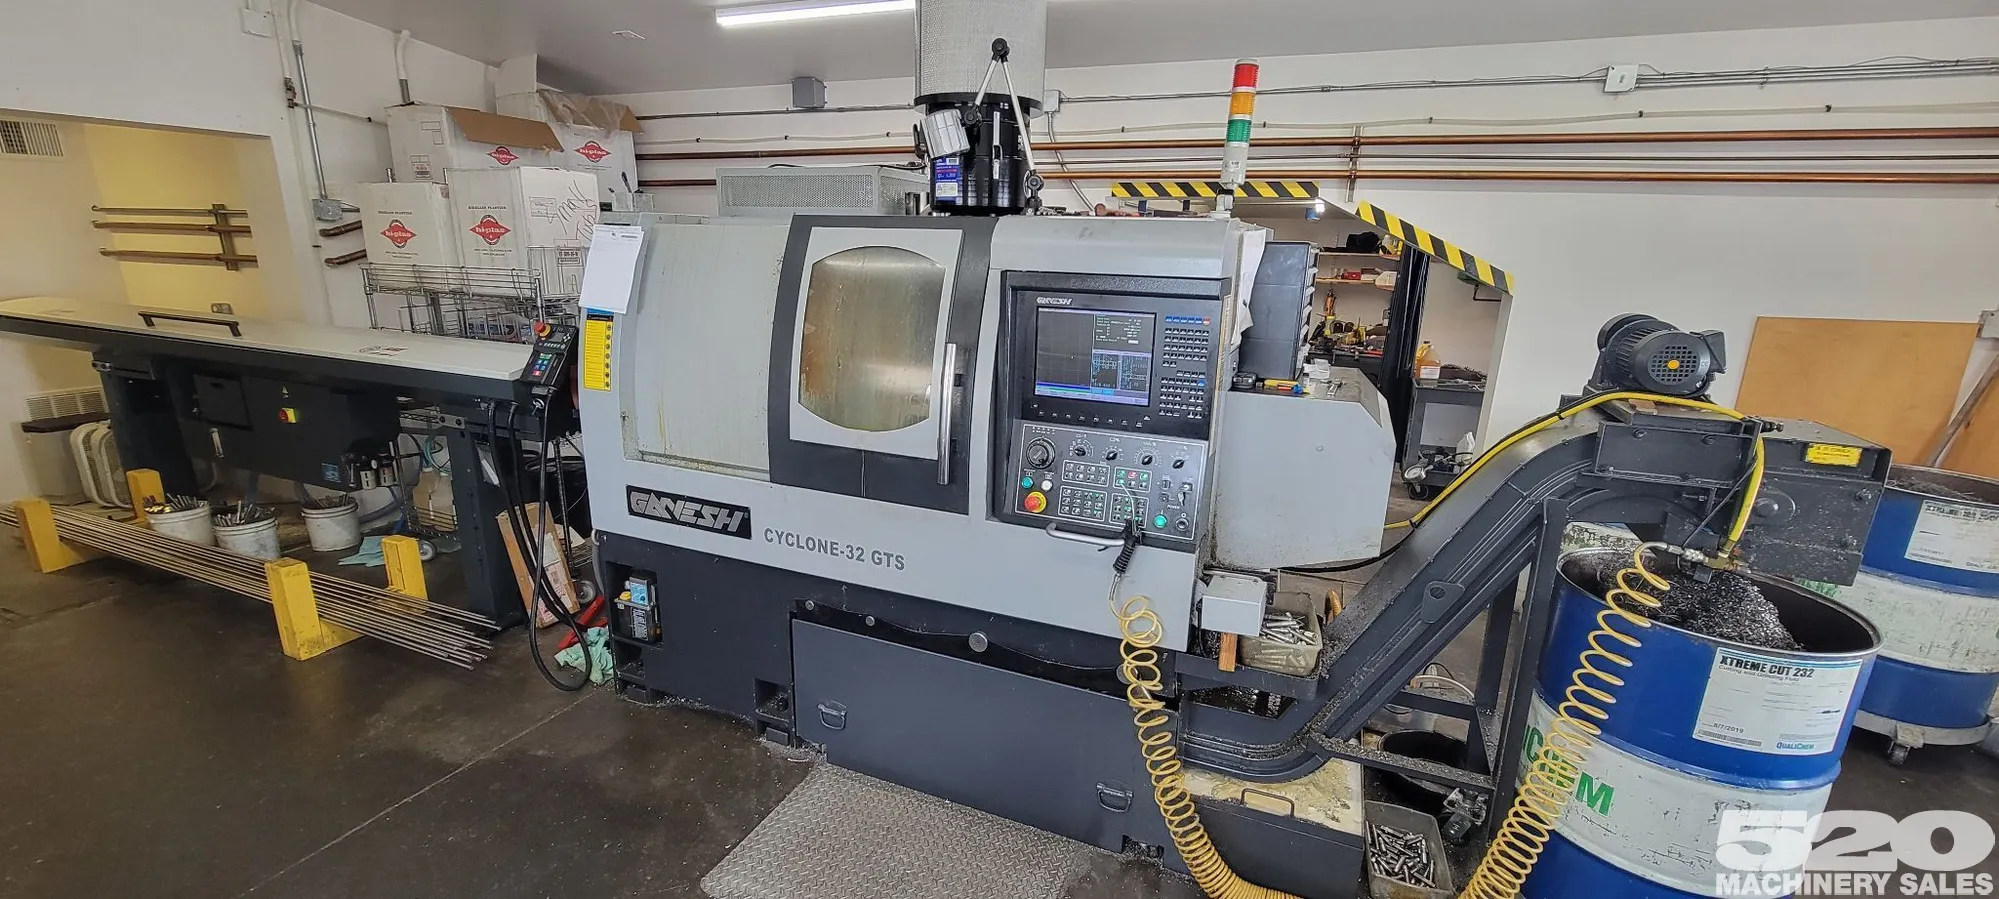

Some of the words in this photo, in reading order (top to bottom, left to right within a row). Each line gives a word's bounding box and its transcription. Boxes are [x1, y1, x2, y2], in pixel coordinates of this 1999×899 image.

[629, 491, 745, 533] GANESH
[763, 527, 866, 563] CYCLONE-32
[871, 549, 906, 571] GTS
[1718, 664, 1742, 674] Cutting
[1719, 654, 1767, 672] XTREME
[1768, 664, 1793, 676] CUT
[1792, 667, 1815, 678] 232
